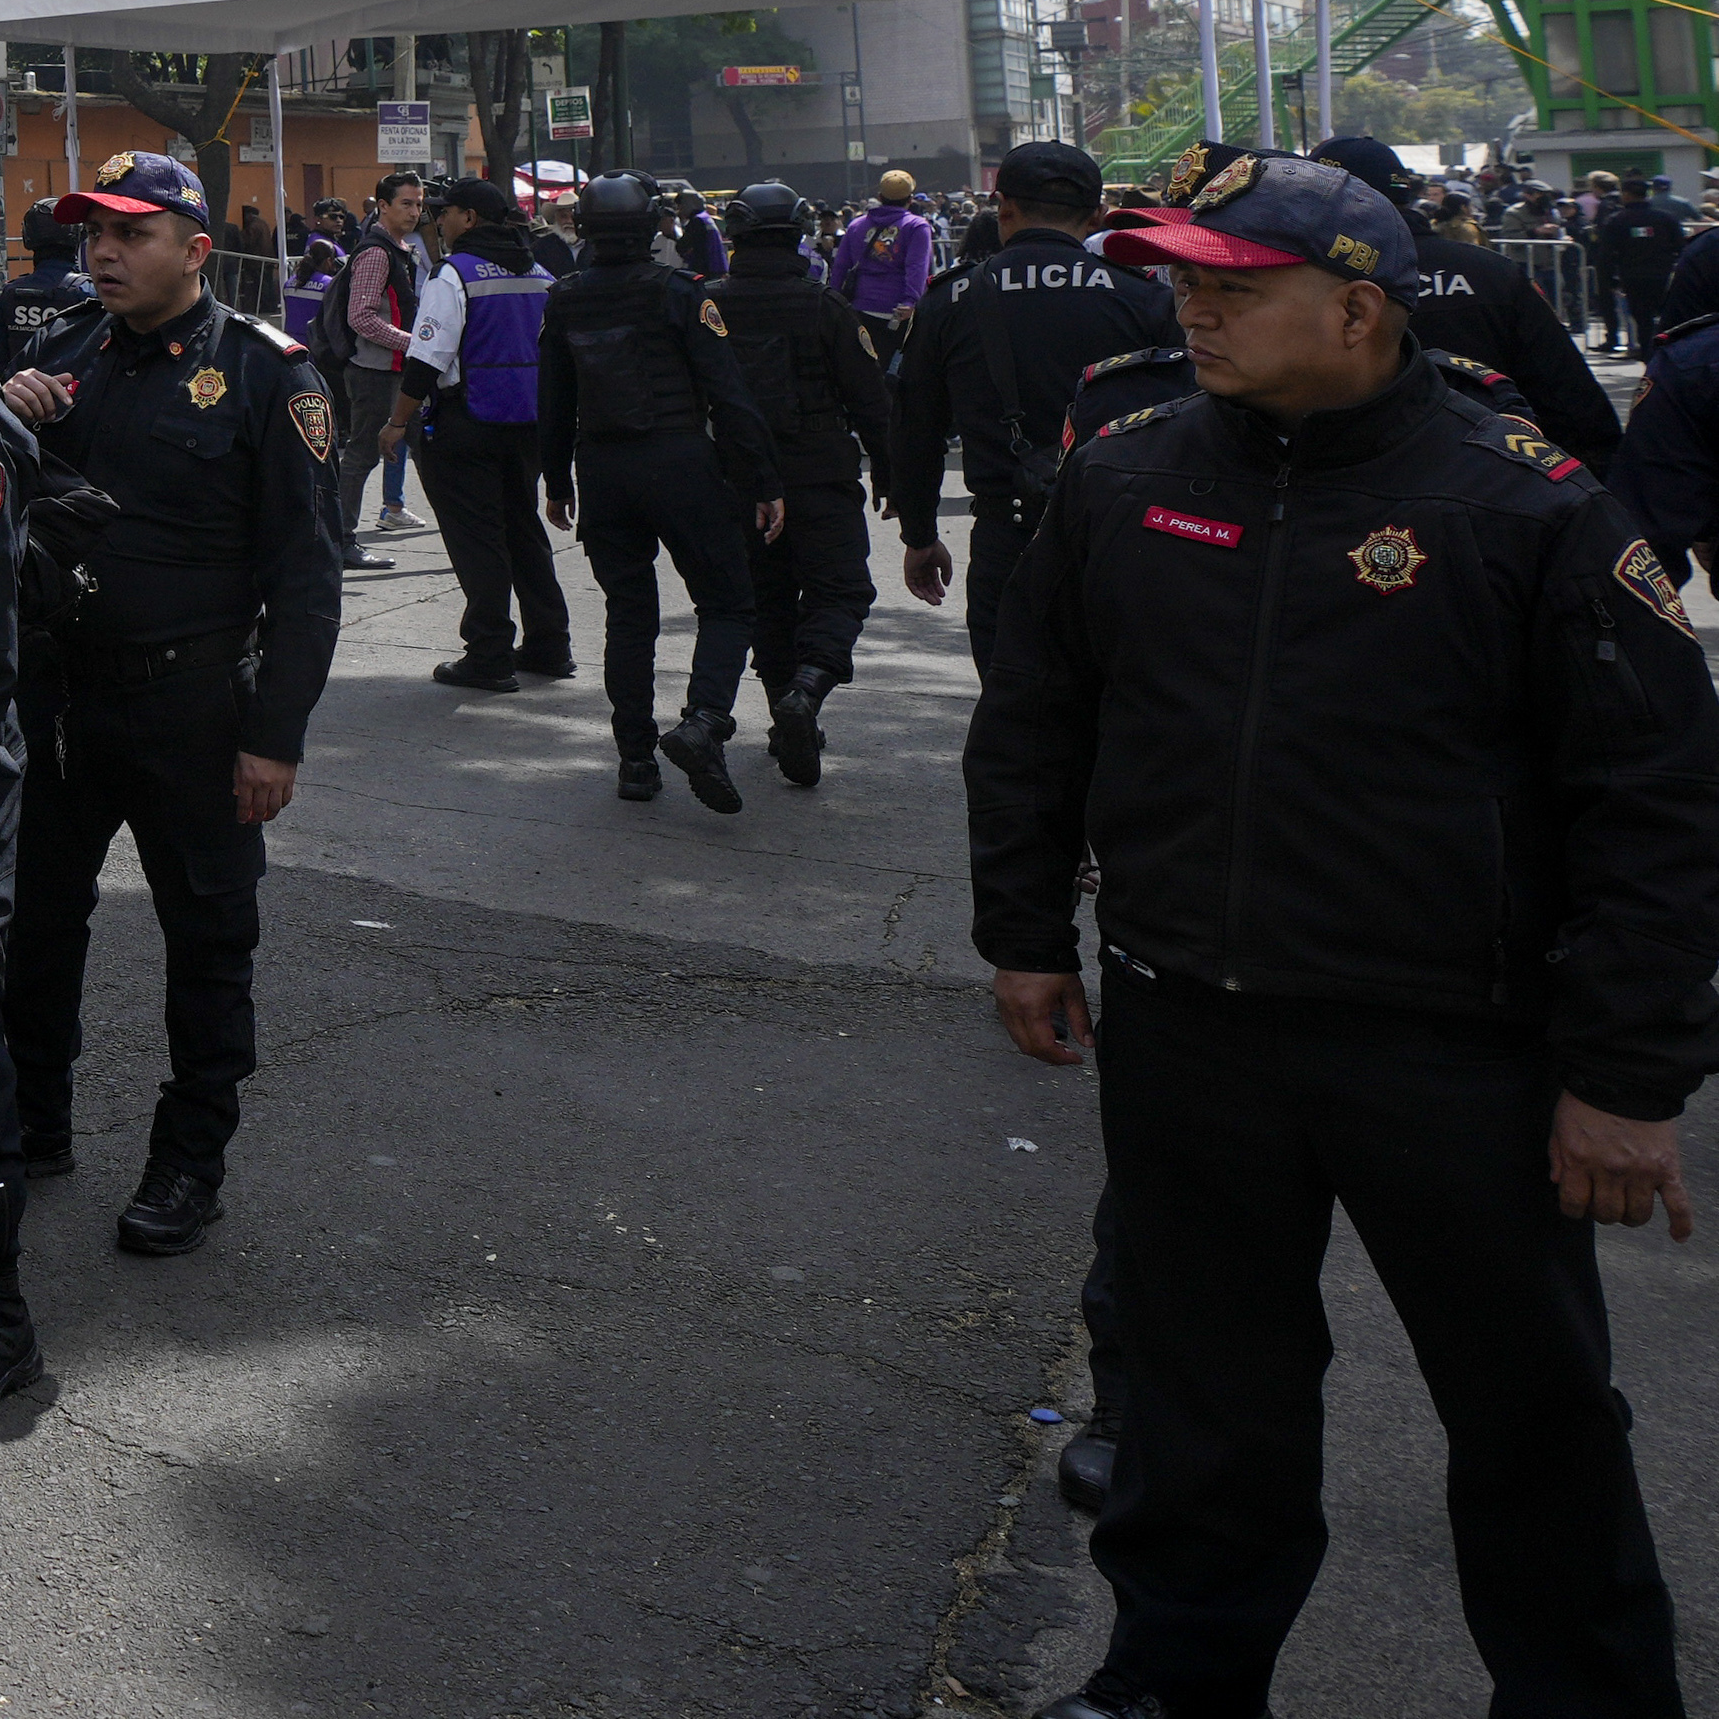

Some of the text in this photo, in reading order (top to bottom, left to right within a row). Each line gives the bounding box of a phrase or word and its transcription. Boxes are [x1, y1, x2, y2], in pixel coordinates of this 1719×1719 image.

[380, 127, 428, 136] RENTA OFICINAS
[405, 137, 420, 145] ZONA
[181, 185, 202, 205] SSC
[1326, 233, 1381, 276] PBI
[951, 262, 1115, 304] PLICÍA
[1152, 514, 1230, 540] J. PEREA M.
[1624, 546, 1658, 581] POLIC
